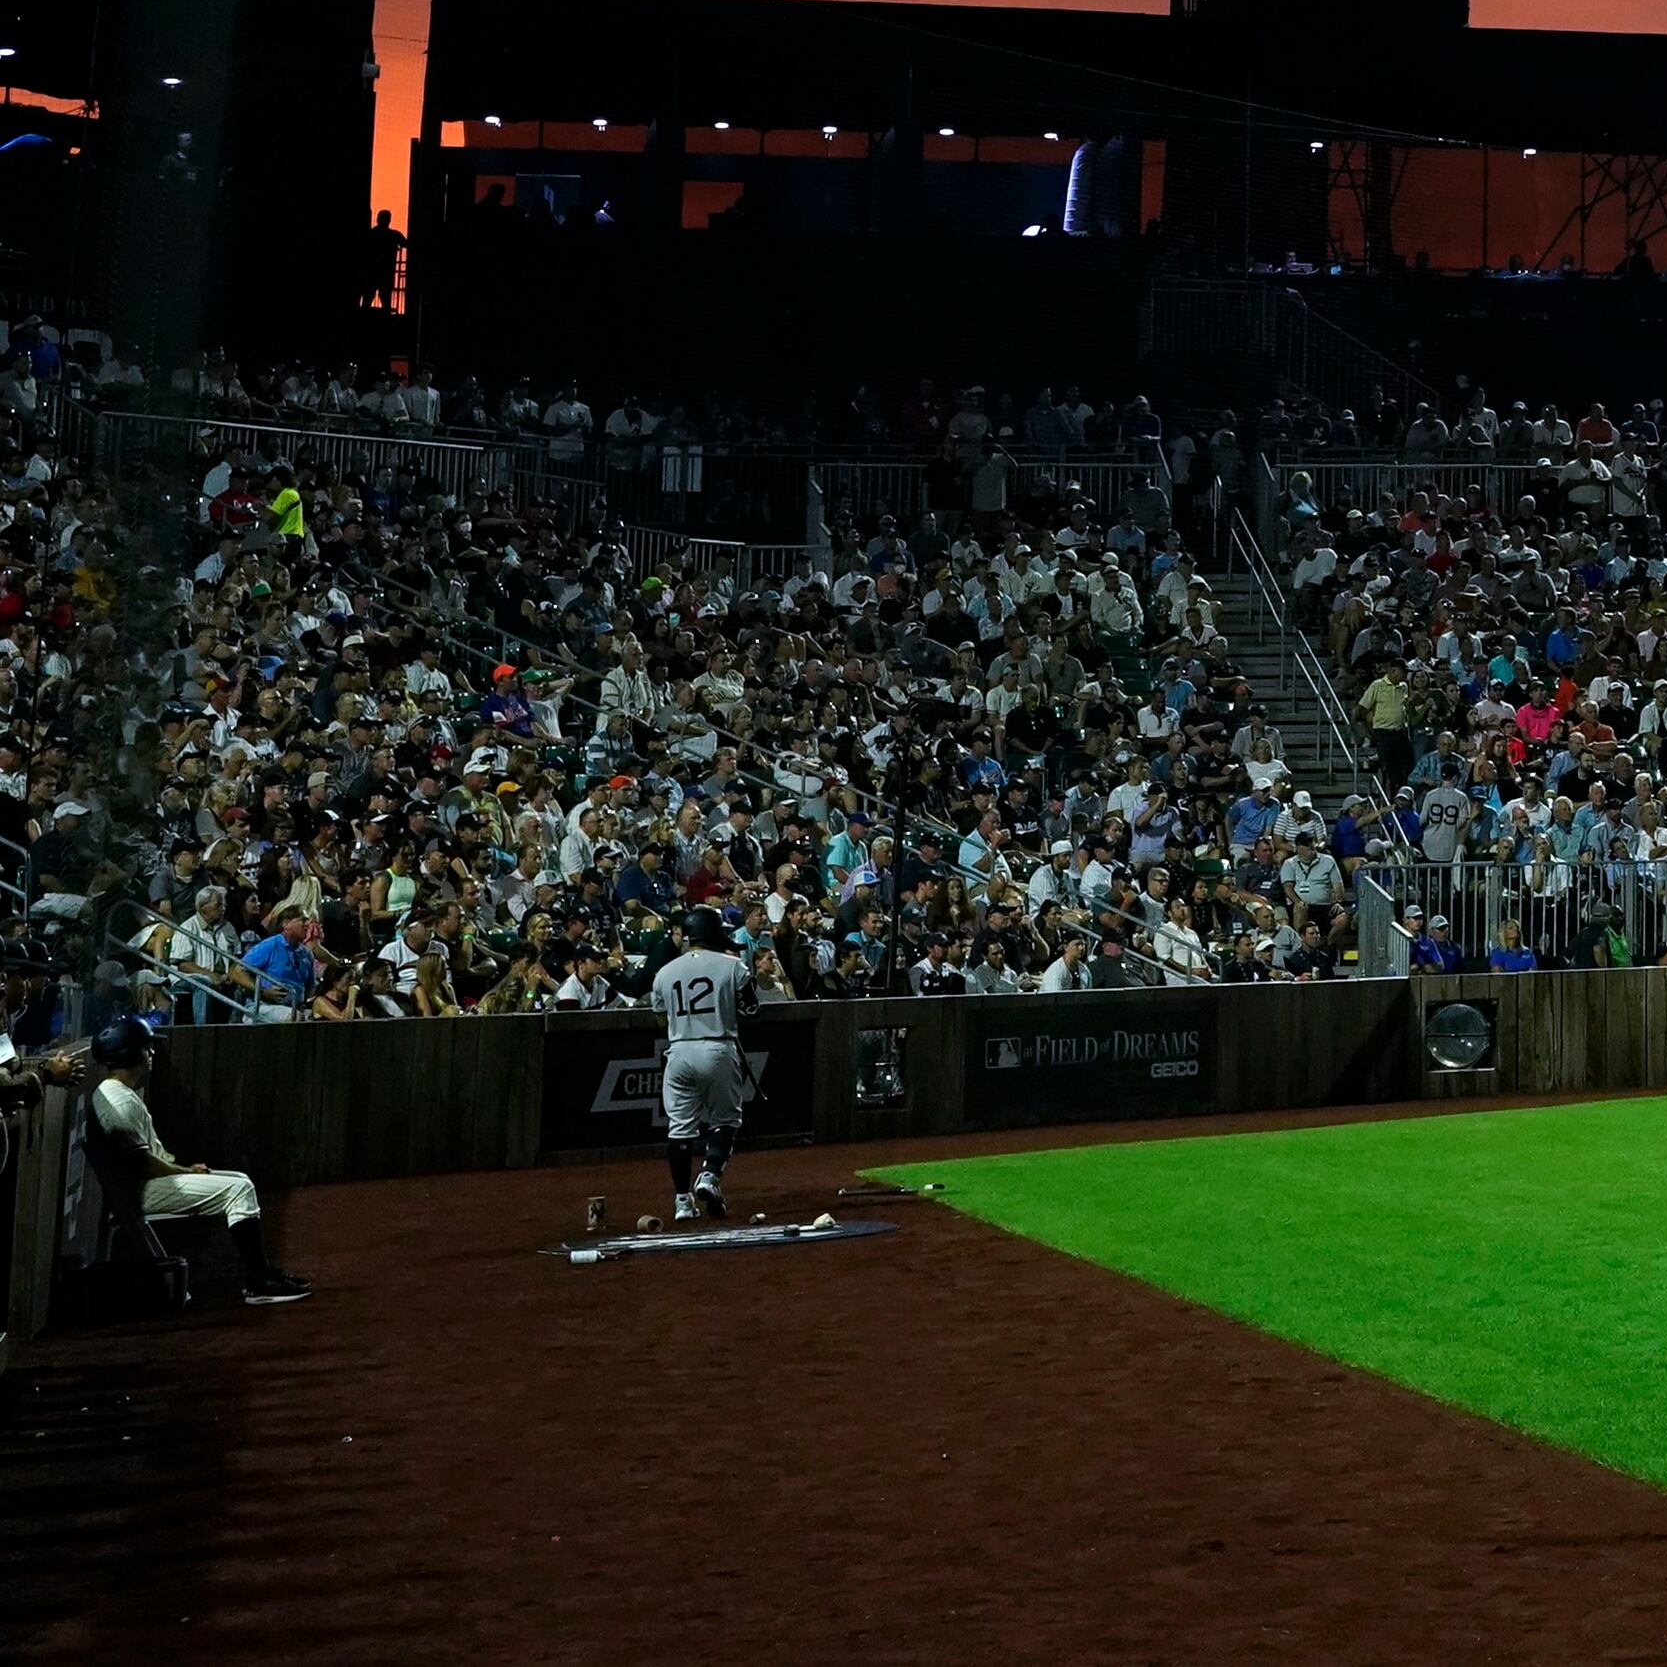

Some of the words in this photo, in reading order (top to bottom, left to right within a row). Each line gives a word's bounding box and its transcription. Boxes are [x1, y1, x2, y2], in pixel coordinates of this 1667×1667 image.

[1429, 803, 1459, 825] 99
[672, 976, 715, 1017] 12
[1151, 1060, 1200, 1079] GEICO
